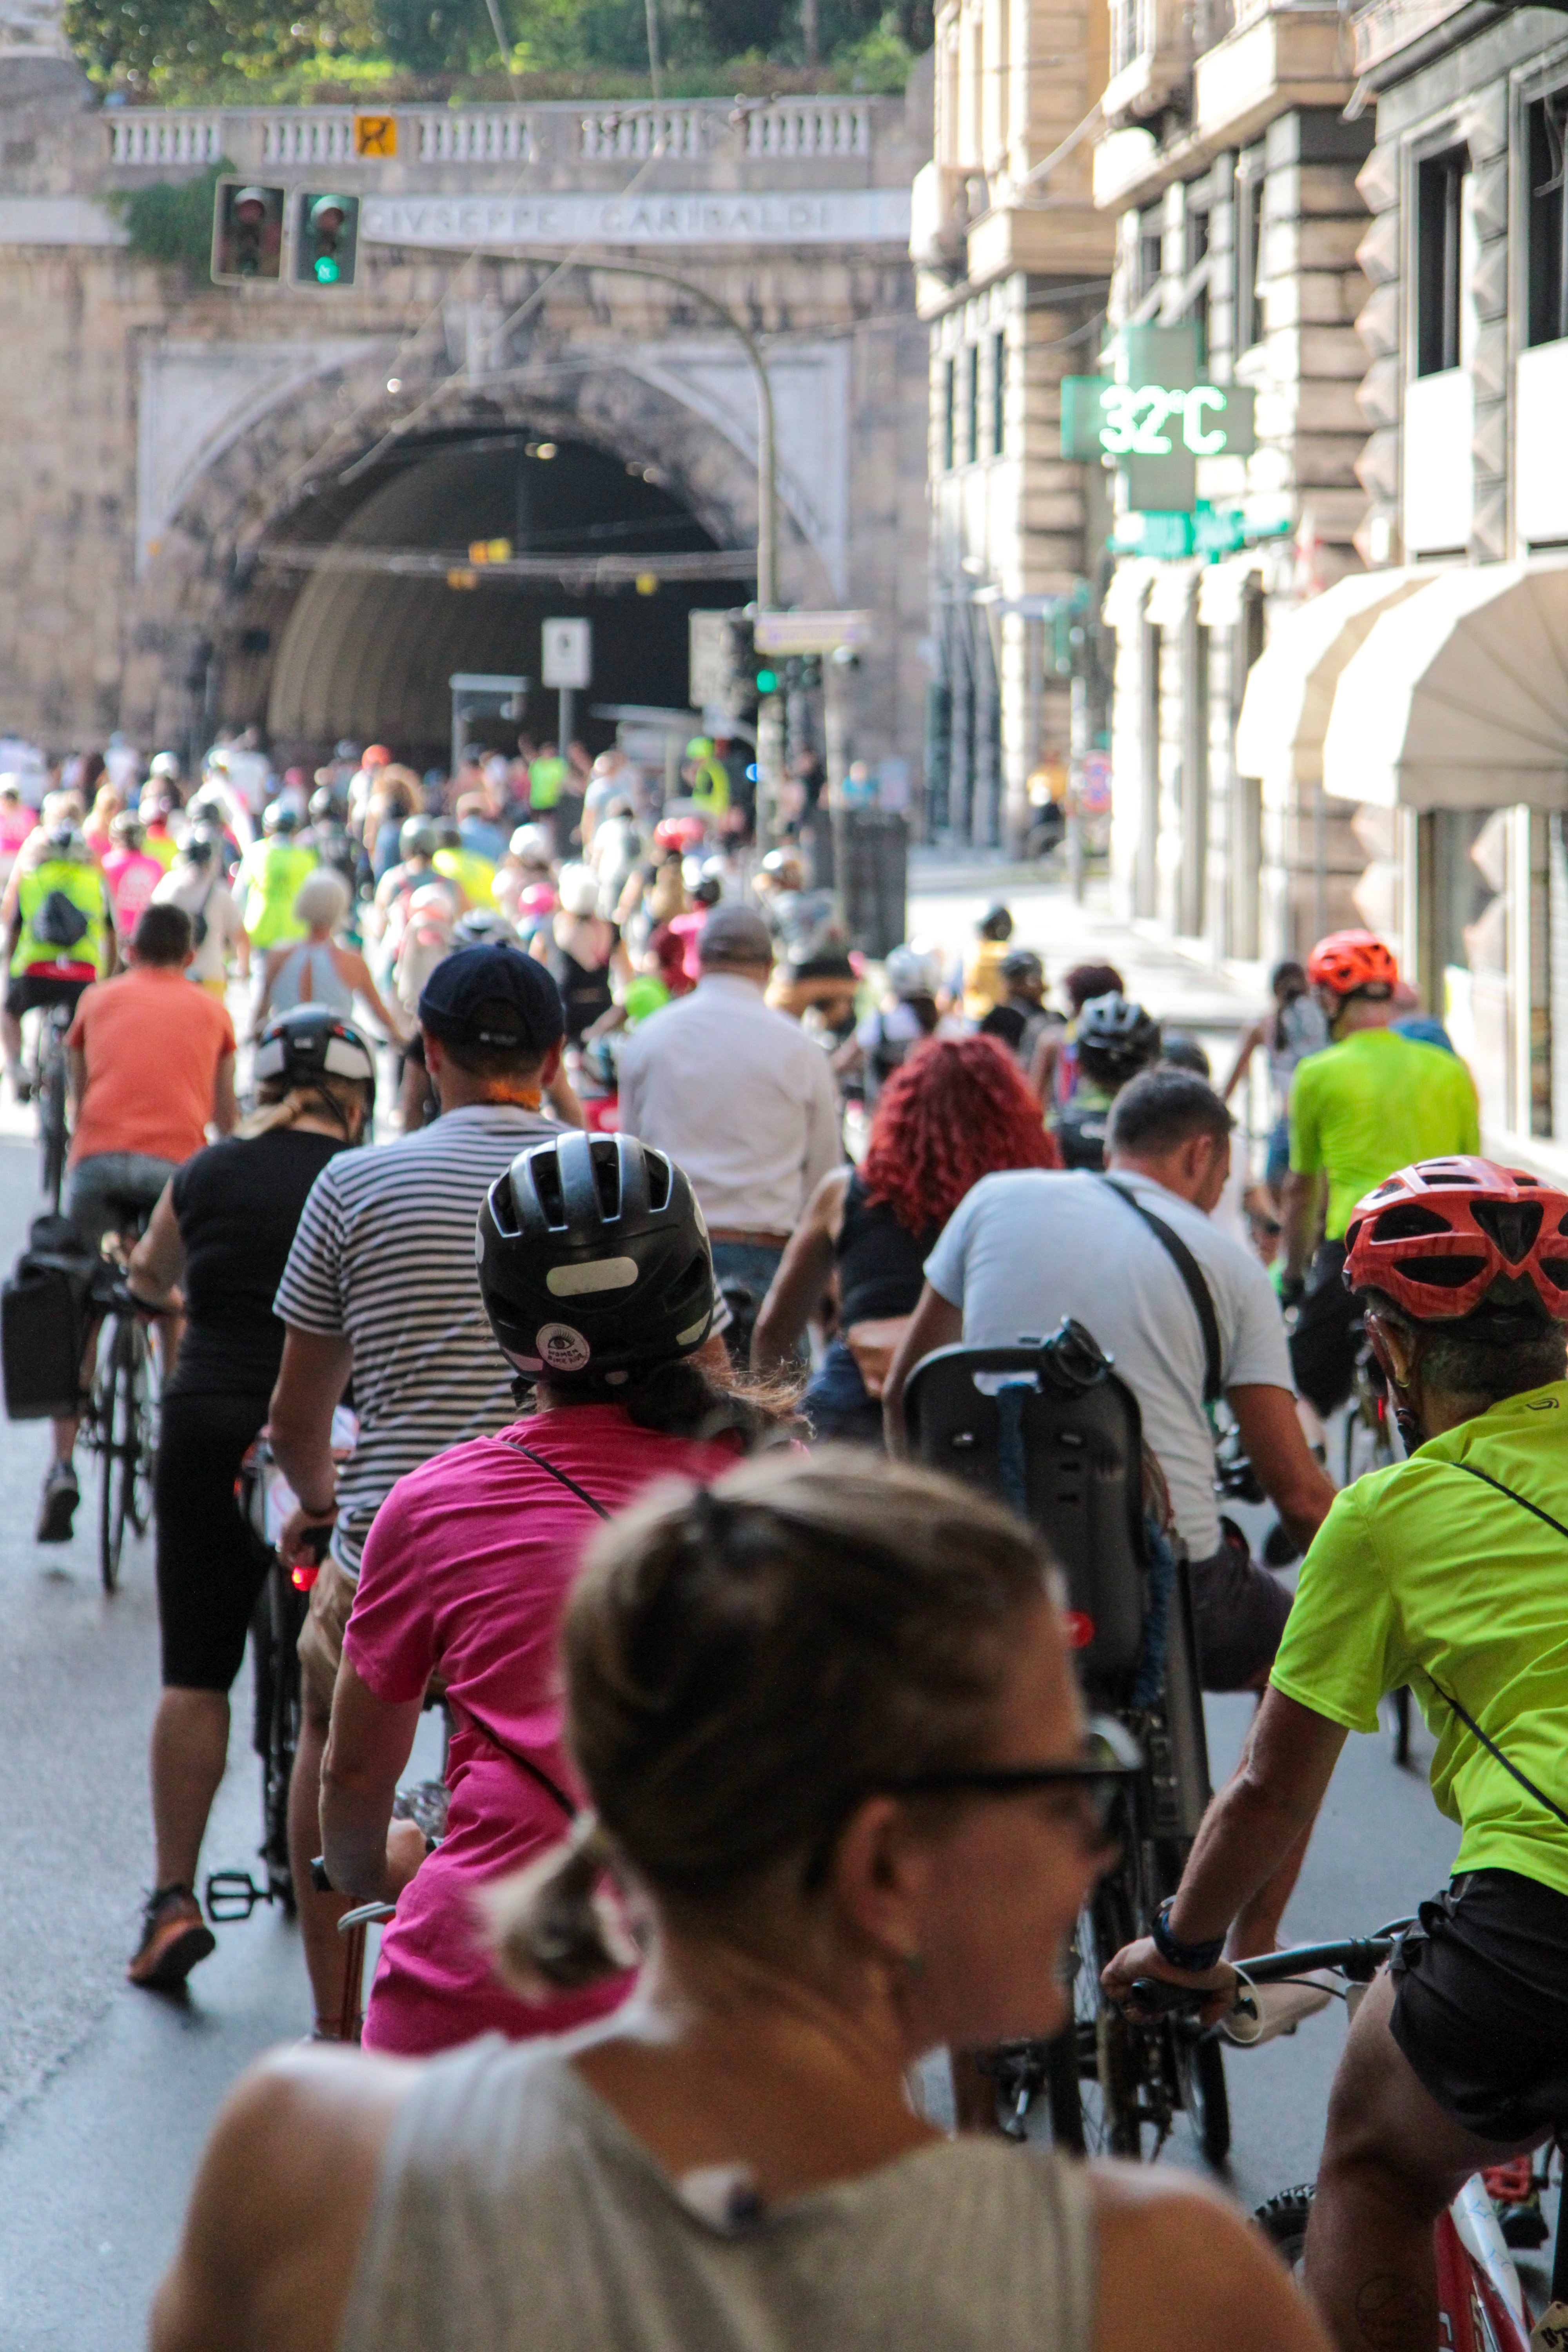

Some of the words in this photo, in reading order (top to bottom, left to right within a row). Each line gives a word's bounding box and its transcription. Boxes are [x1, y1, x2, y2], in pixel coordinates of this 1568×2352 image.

[601, 200, 828, 236] GARIBALDI
[548, 1348, 579, 1357] WOMEN
[548, 1355, 567, 1364] BIKE
